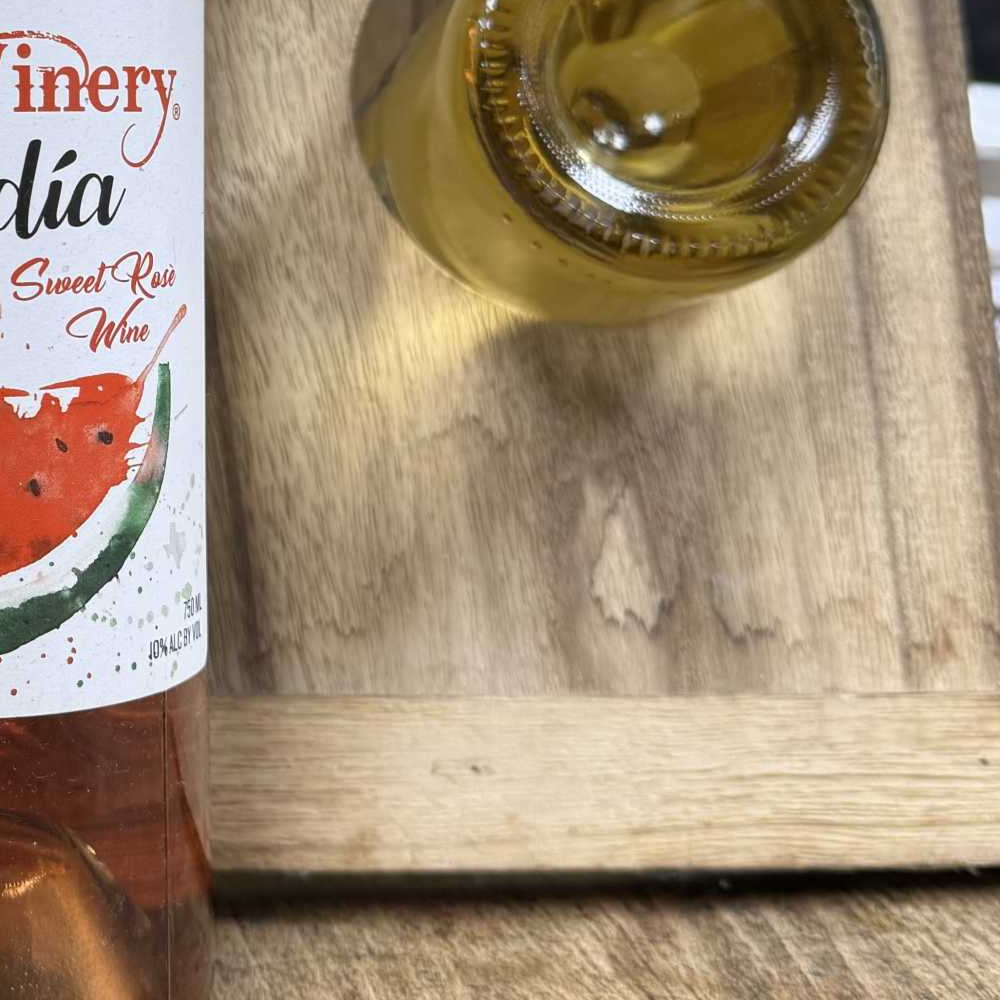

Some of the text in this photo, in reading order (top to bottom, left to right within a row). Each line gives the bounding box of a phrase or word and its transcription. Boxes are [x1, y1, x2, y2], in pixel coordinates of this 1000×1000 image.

[10, 257, 107, 301] Sweet
[65, 298, 151, 353] Wine
[183, 597, 195, 620] 750
[148, 636, 169, 660] 10%
[168, 630, 183, 654] ALC
[183, 624, 193, 647] BY
